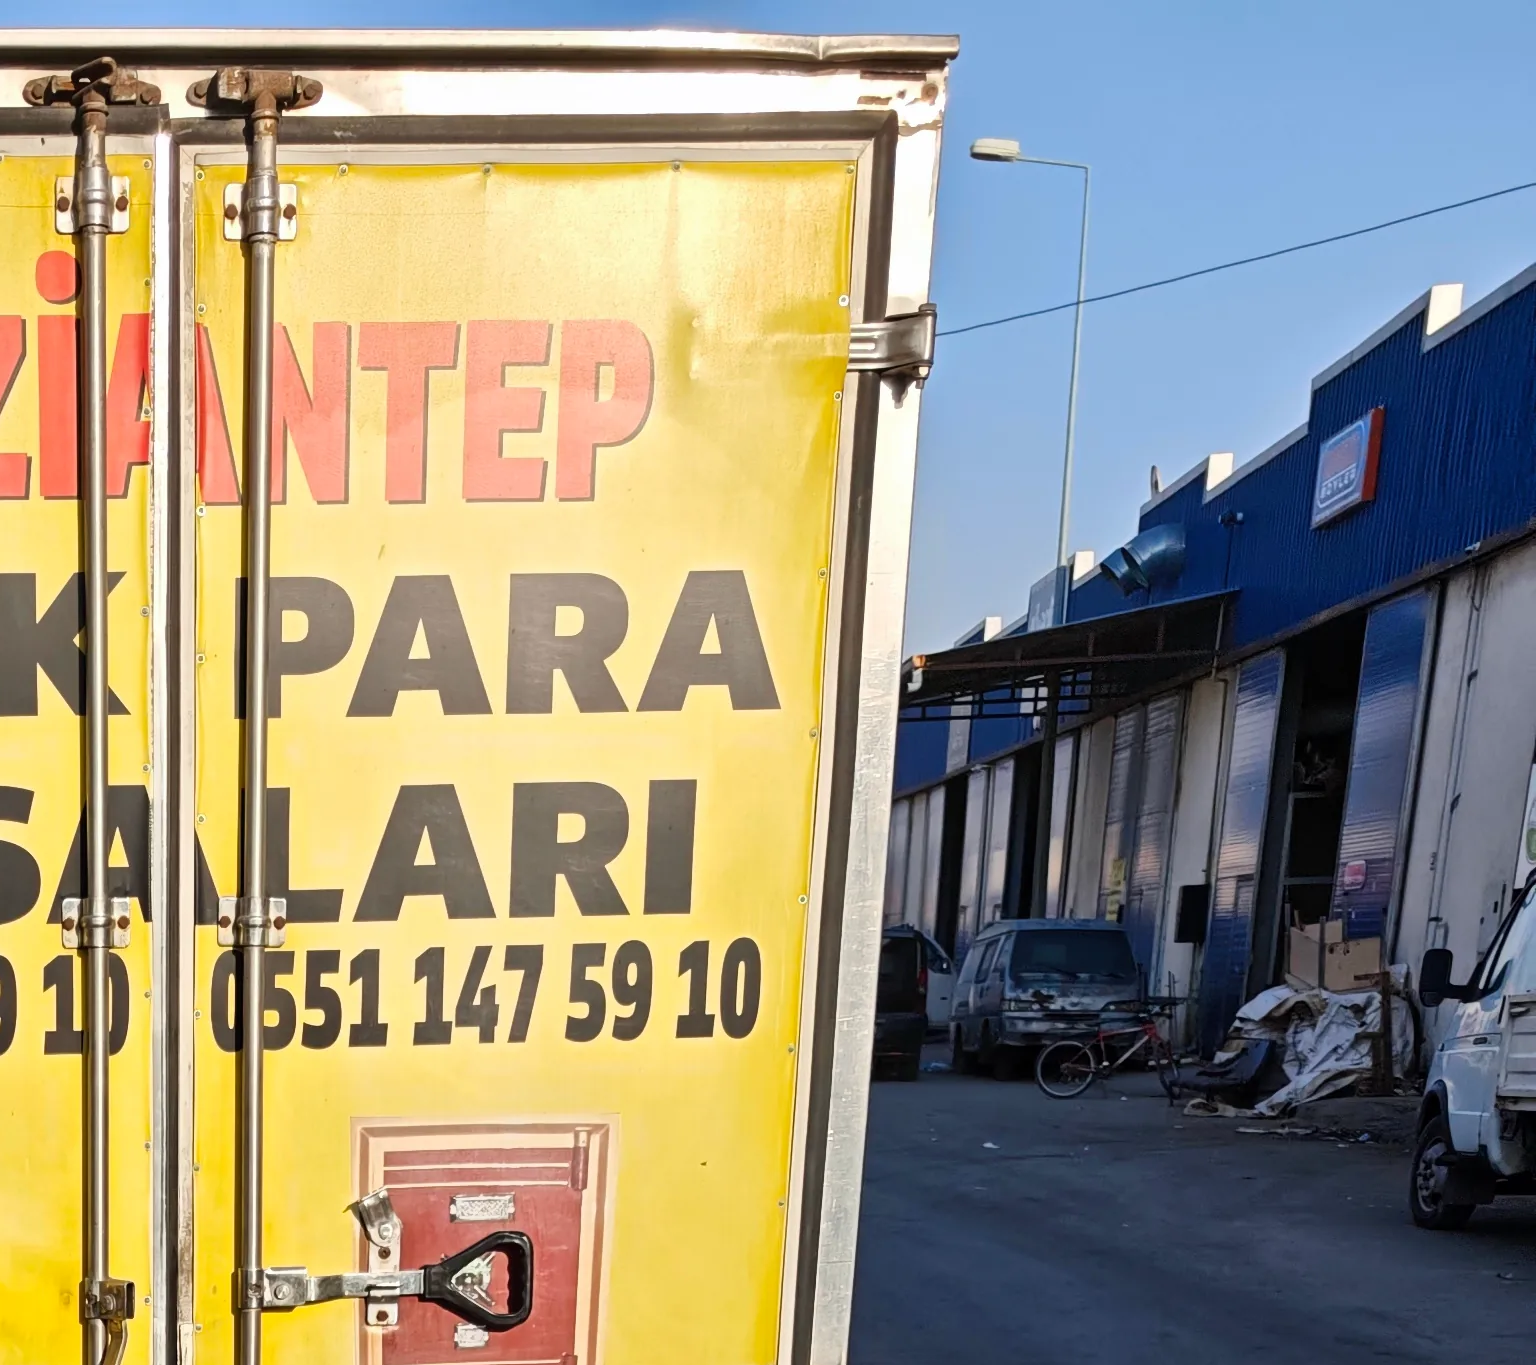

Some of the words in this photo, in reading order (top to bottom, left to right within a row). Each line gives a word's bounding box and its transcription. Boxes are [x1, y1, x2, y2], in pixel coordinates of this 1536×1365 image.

[234, 569, 781, 720] PARA
[43, 953, 130, 1056] 10
[210, 946, 389, 1053] 0551
[413, 944, 545, 1046] 147
[565, 939, 654, 1042] 59
[675, 936, 762, 1040] 10
